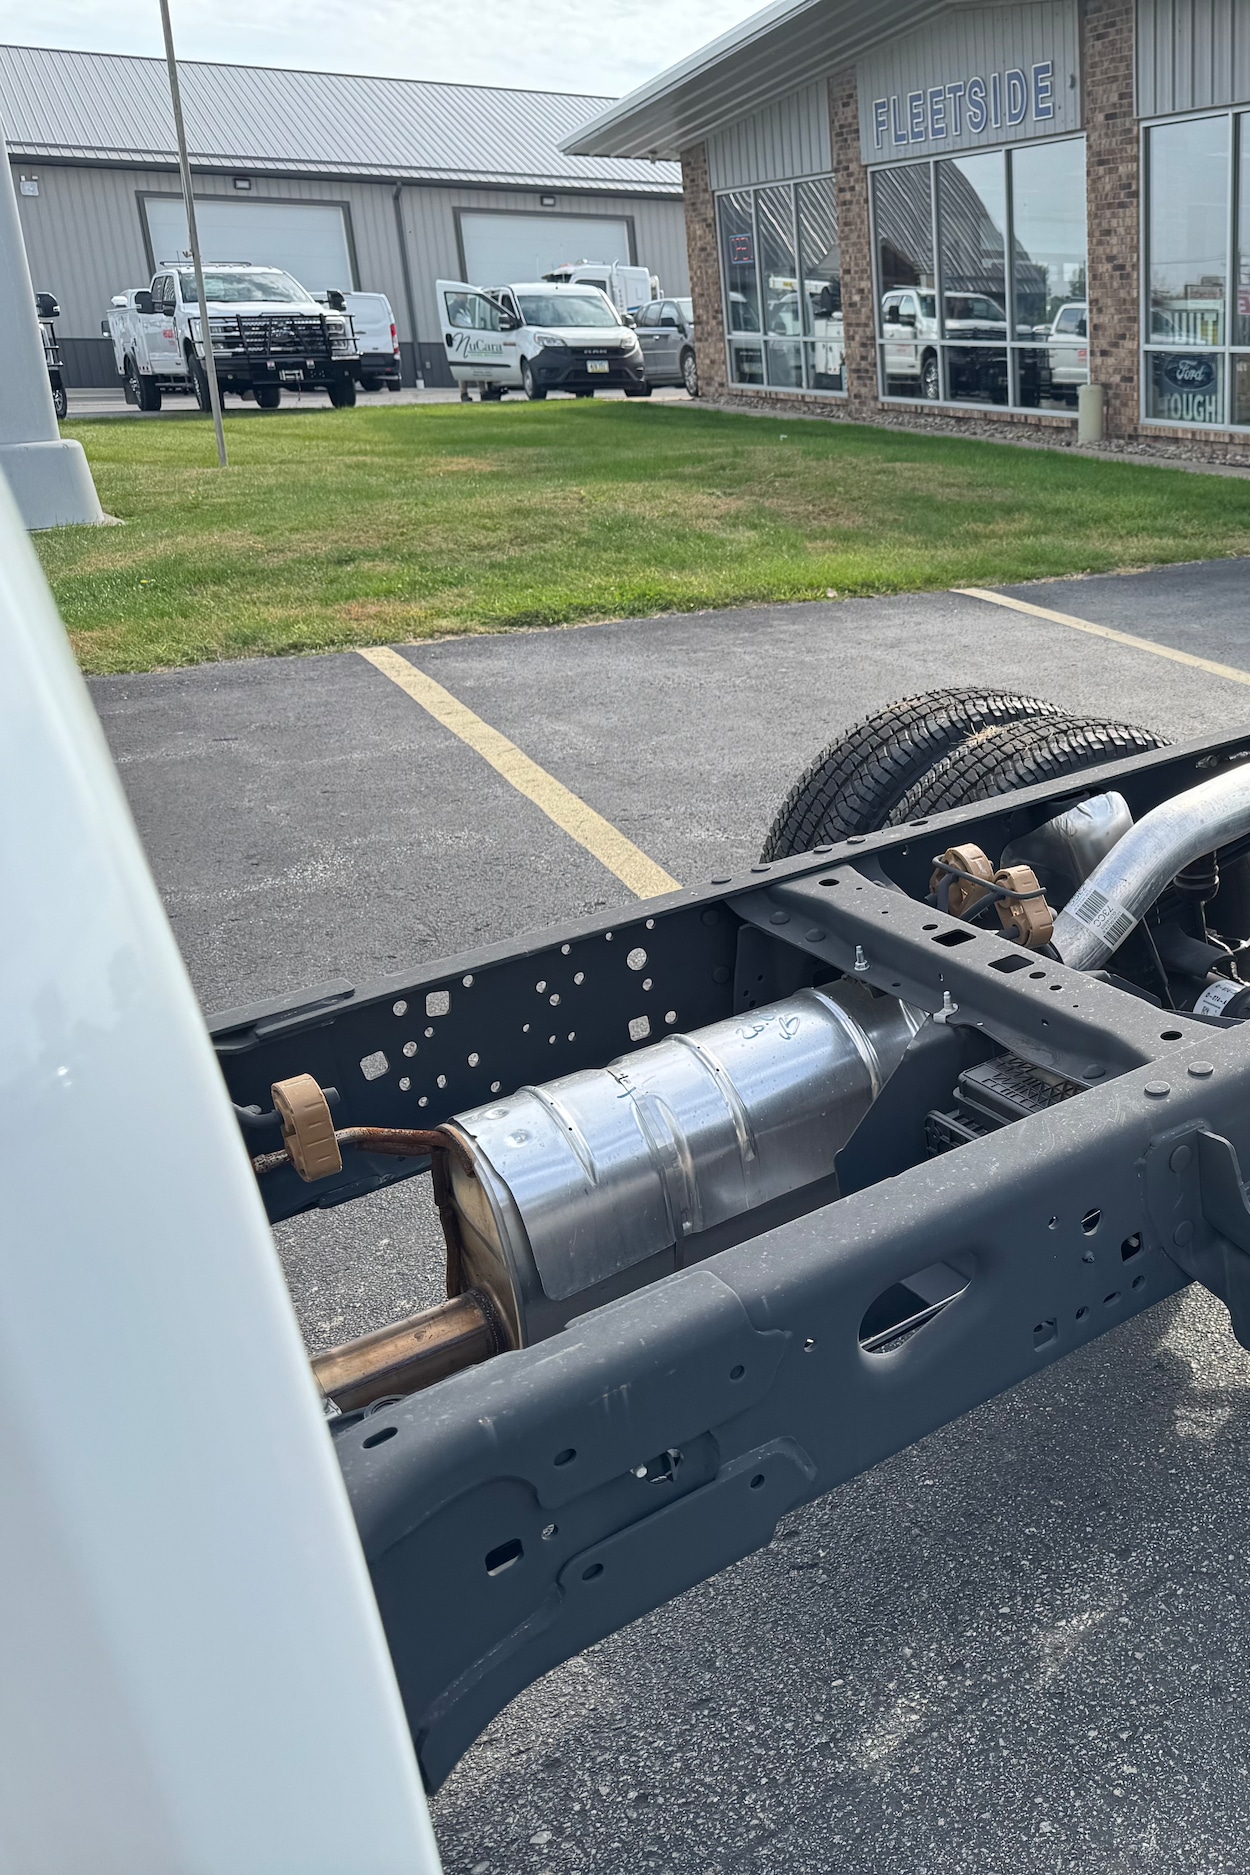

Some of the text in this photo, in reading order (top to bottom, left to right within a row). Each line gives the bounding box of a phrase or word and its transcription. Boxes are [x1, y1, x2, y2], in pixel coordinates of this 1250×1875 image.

[872, 60, 1054, 149] FLEETSIDE
[453, 332, 503, 359] NuCara
[1175, 359, 1207, 381] Ford
[1093, 905, 1113, 928] 73CC
